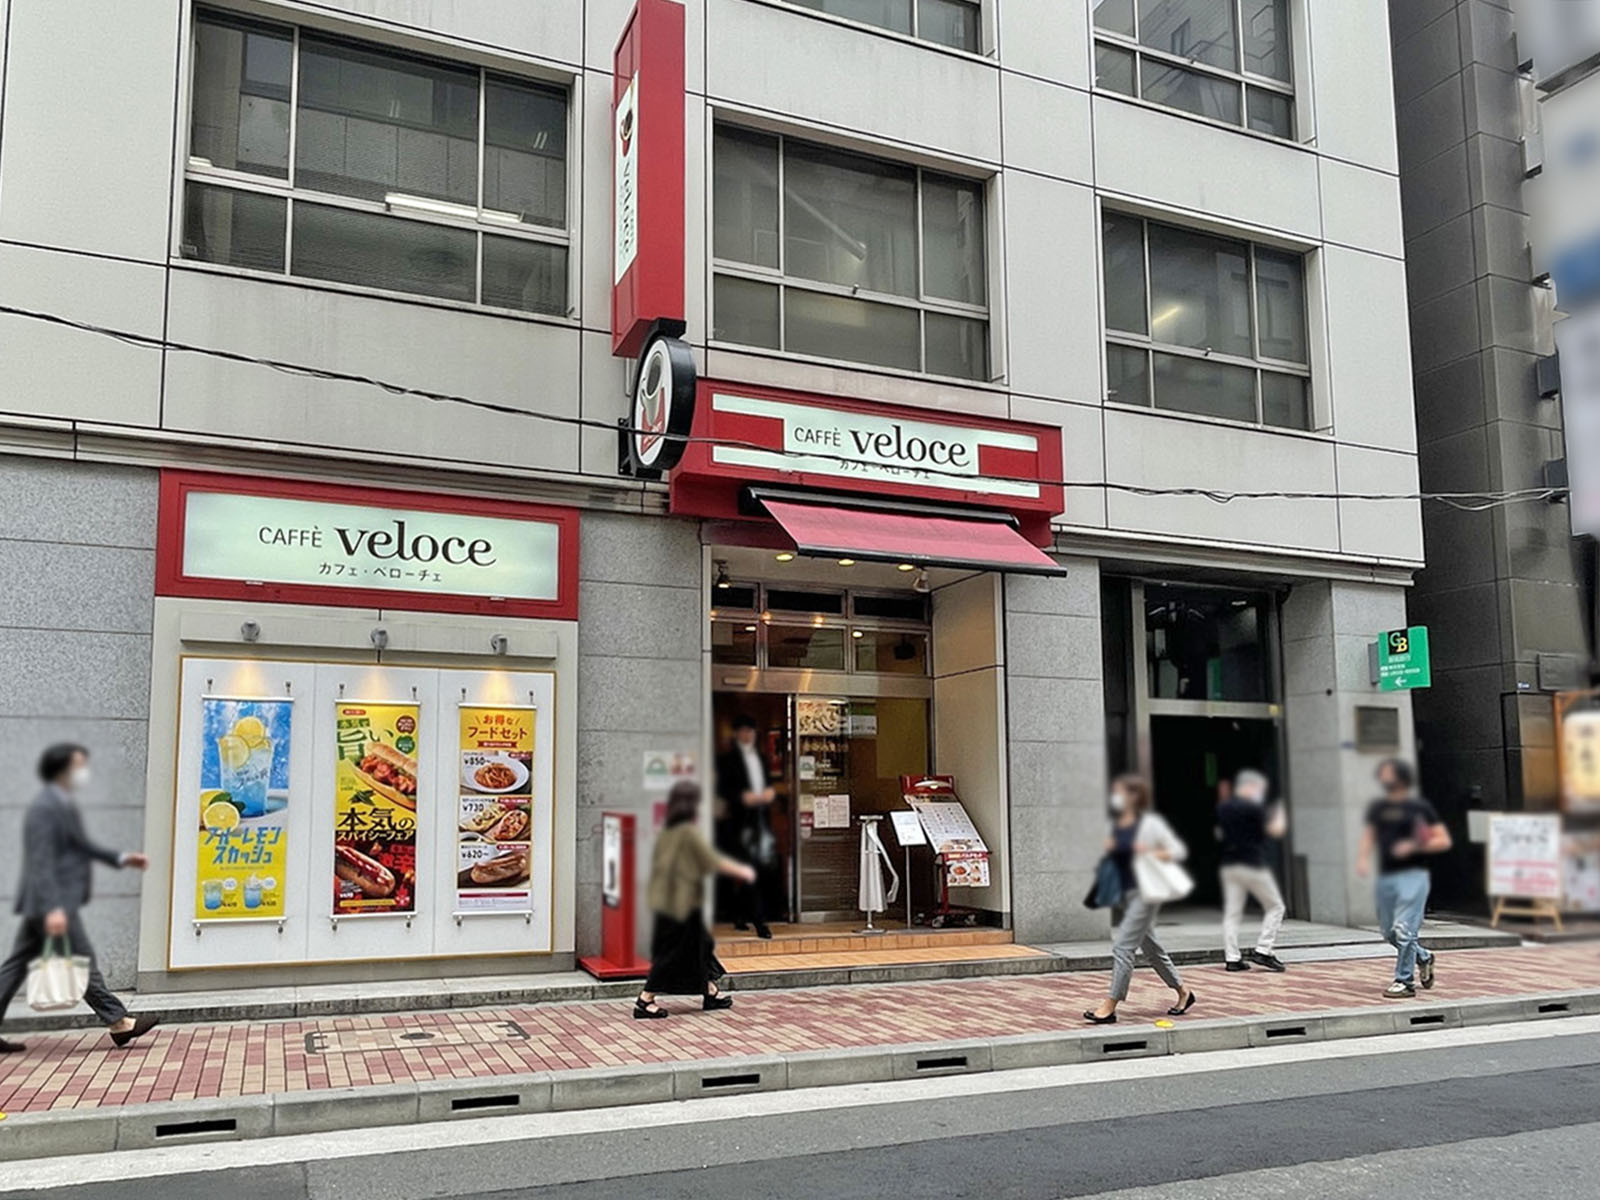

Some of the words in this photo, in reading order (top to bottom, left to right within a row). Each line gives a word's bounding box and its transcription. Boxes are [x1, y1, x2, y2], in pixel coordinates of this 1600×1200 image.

[794, 427, 842, 447] CAFFÈ
[849, 425, 971, 467] veloce
[258, 525, 323, 549] CAFFÈ
[334, 519, 497, 567] veloce
[319, 561, 443, 583] カフェ・ベローチェ
[468, 726, 528, 740] フードセット
[338, 807, 415, 832] 本気の
[336, 830, 415, 842] スパイシーフェア
[212, 844, 273, 865] スカッシュ
